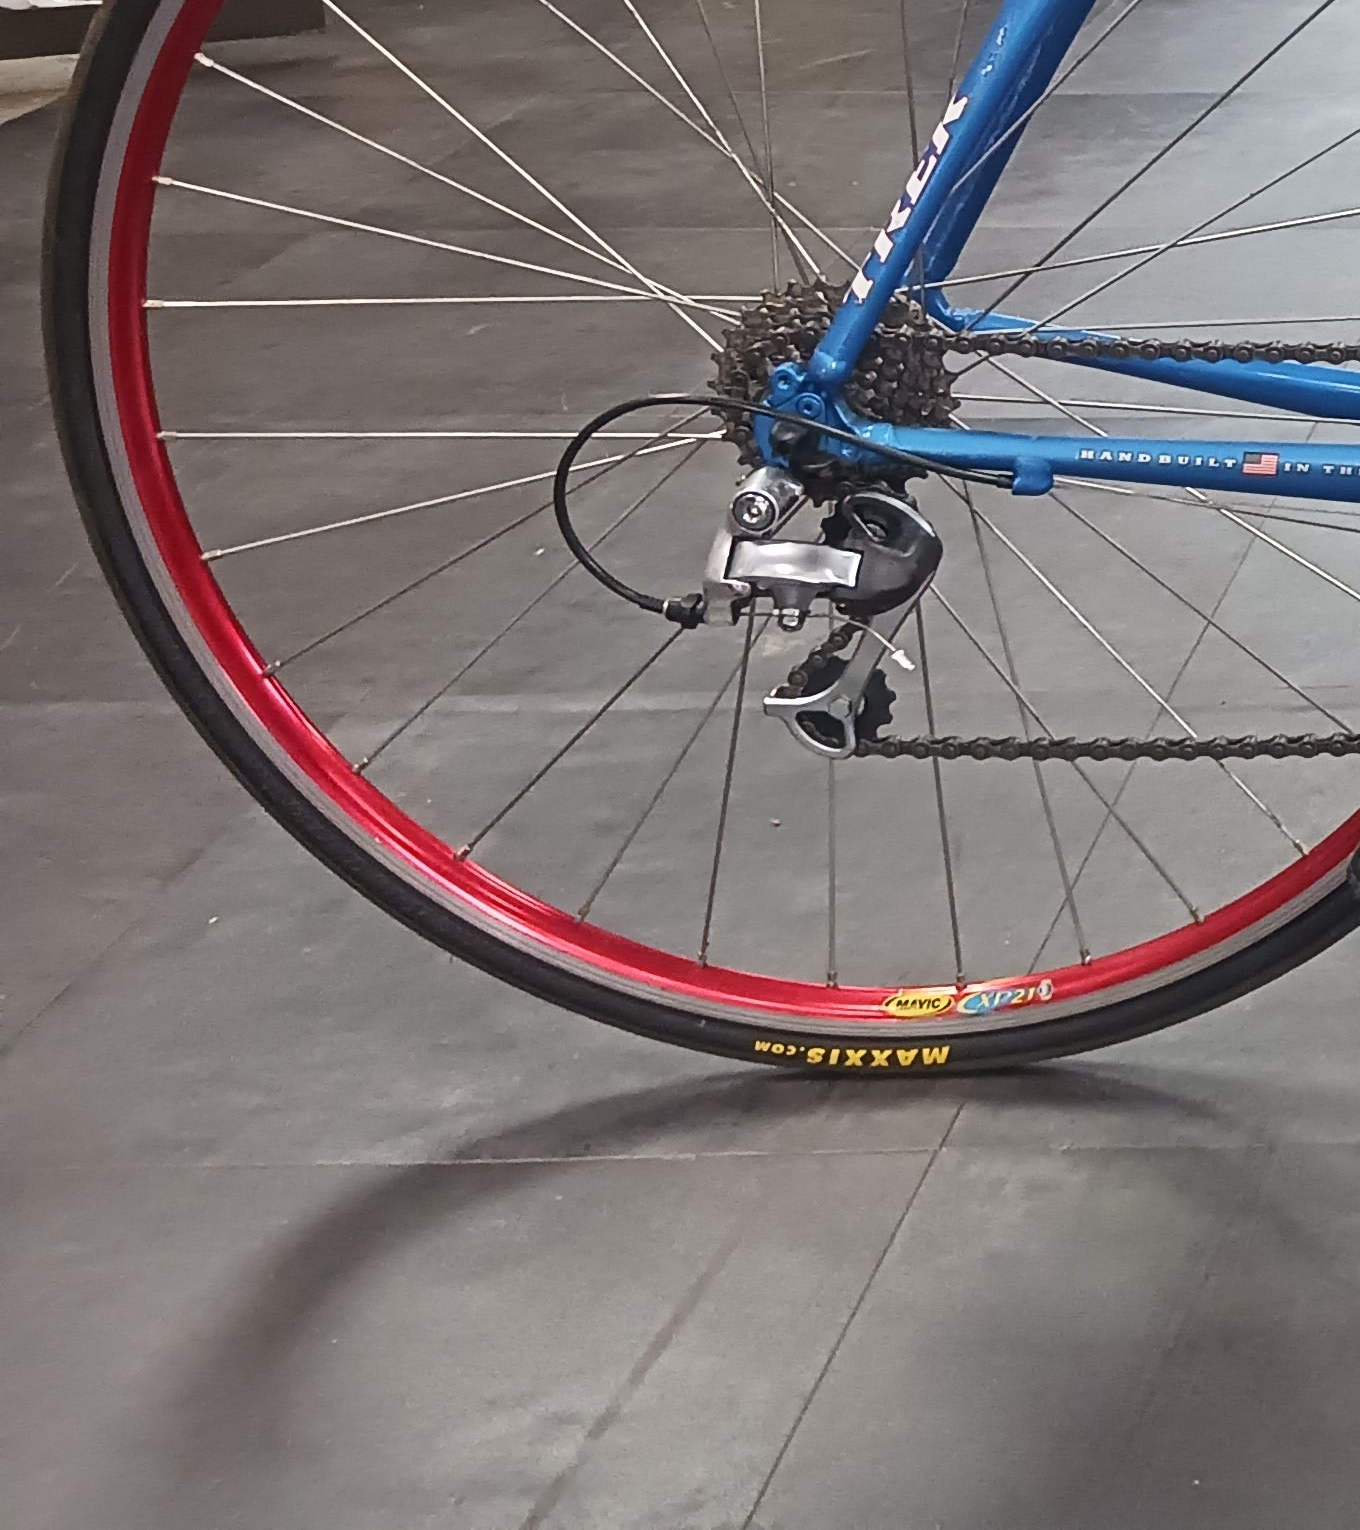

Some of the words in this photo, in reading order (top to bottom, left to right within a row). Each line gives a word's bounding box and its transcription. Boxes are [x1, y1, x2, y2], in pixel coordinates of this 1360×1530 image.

[842, 93, 968, 304] TREK
[1283, 462, 1311, 474] IN
[895, 996, 942, 1011] MAVIC
[754, 1039, 951, 1068] MAXXIS.COM
